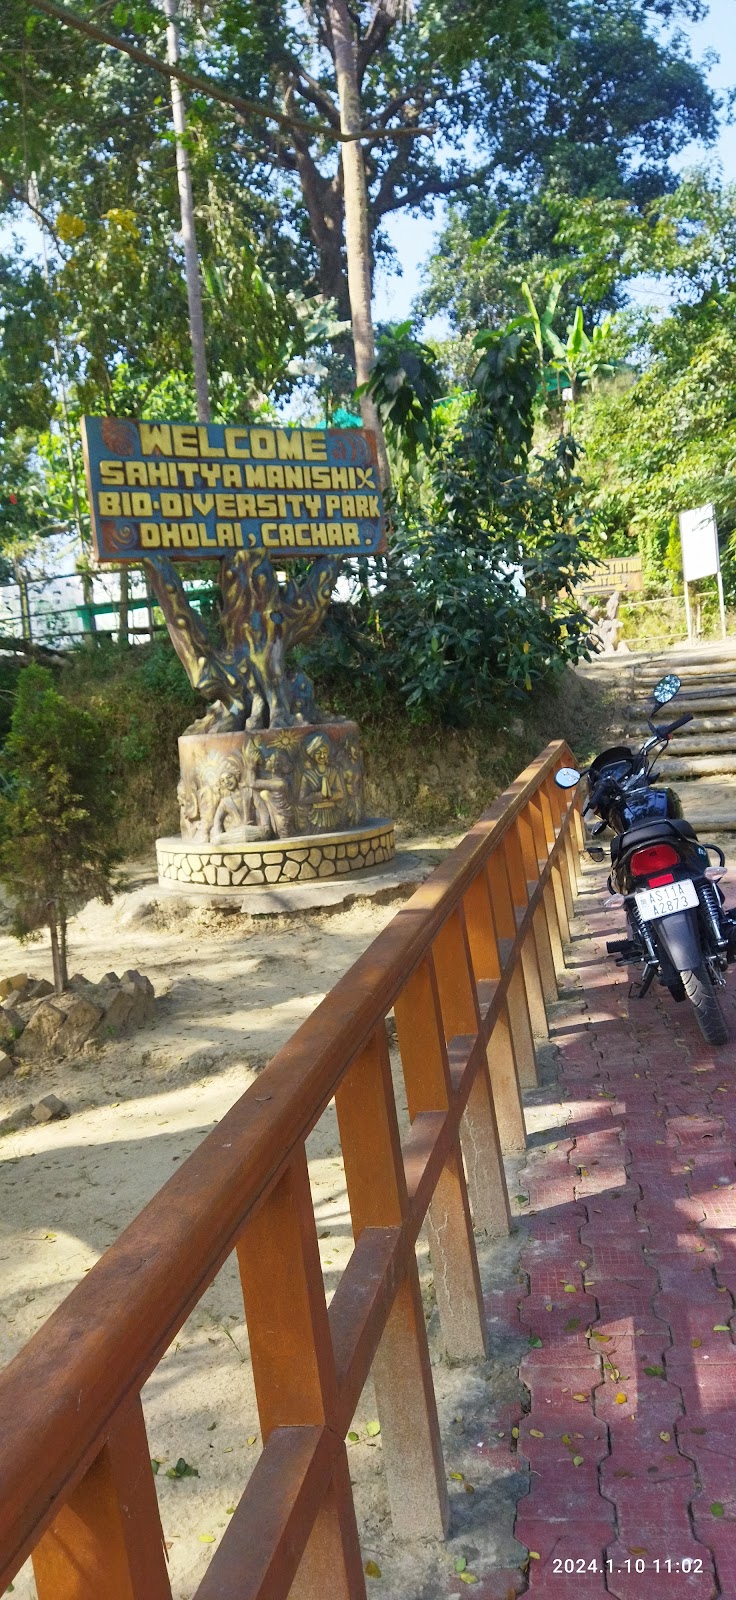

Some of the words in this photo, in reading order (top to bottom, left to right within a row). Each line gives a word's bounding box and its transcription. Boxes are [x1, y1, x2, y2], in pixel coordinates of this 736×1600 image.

[138, 423, 328, 461] WELCOME
[98, 460, 243, 488] SAHITYA
[326, 494, 381, 519] PARK
[649, 884, 684, 903] AS11A
[653, 895, 688, 915] A2873
